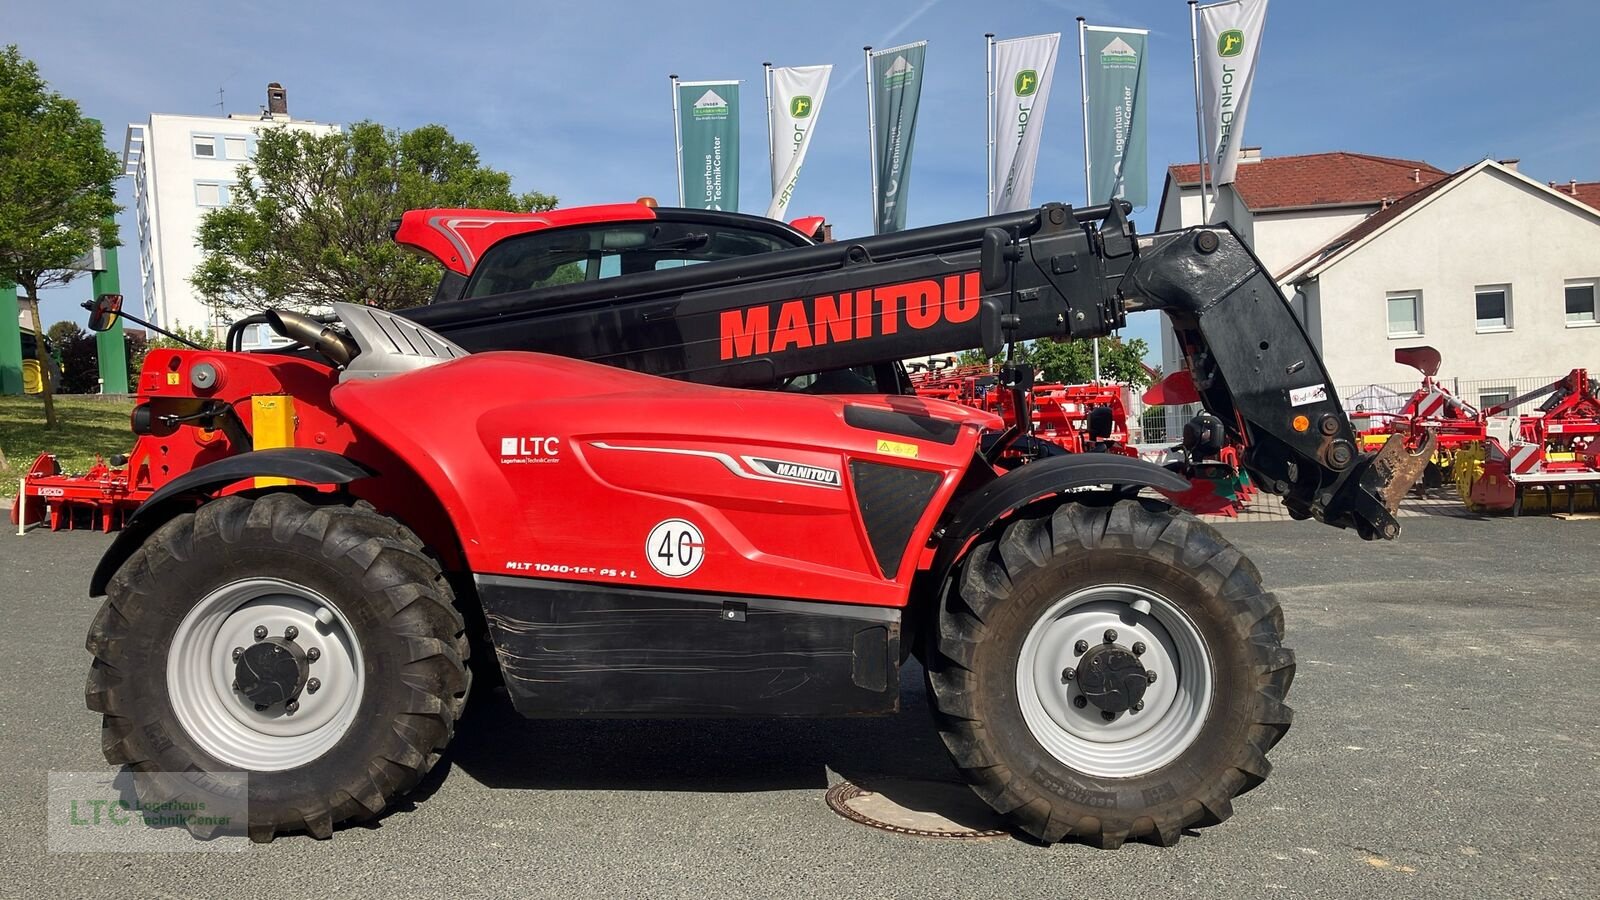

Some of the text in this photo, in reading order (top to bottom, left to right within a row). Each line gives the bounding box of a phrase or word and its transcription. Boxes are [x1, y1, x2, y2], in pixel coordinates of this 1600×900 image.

[1222, 64, 1235, 107] JOHN
[1113, 105, 1124, 158] Lagerhaus
[704, 154, 712, 201] Lagerhaus
[713, 136, 721, 201] TechnikCenter
[720, 271, 980, 360] MANITOU
[520, 436, 560, 456] LTC
[776, 463, 835, 483] MANITOU
[506, 561, 532, 570] MLT
[658, 530, 693, 566] 40
